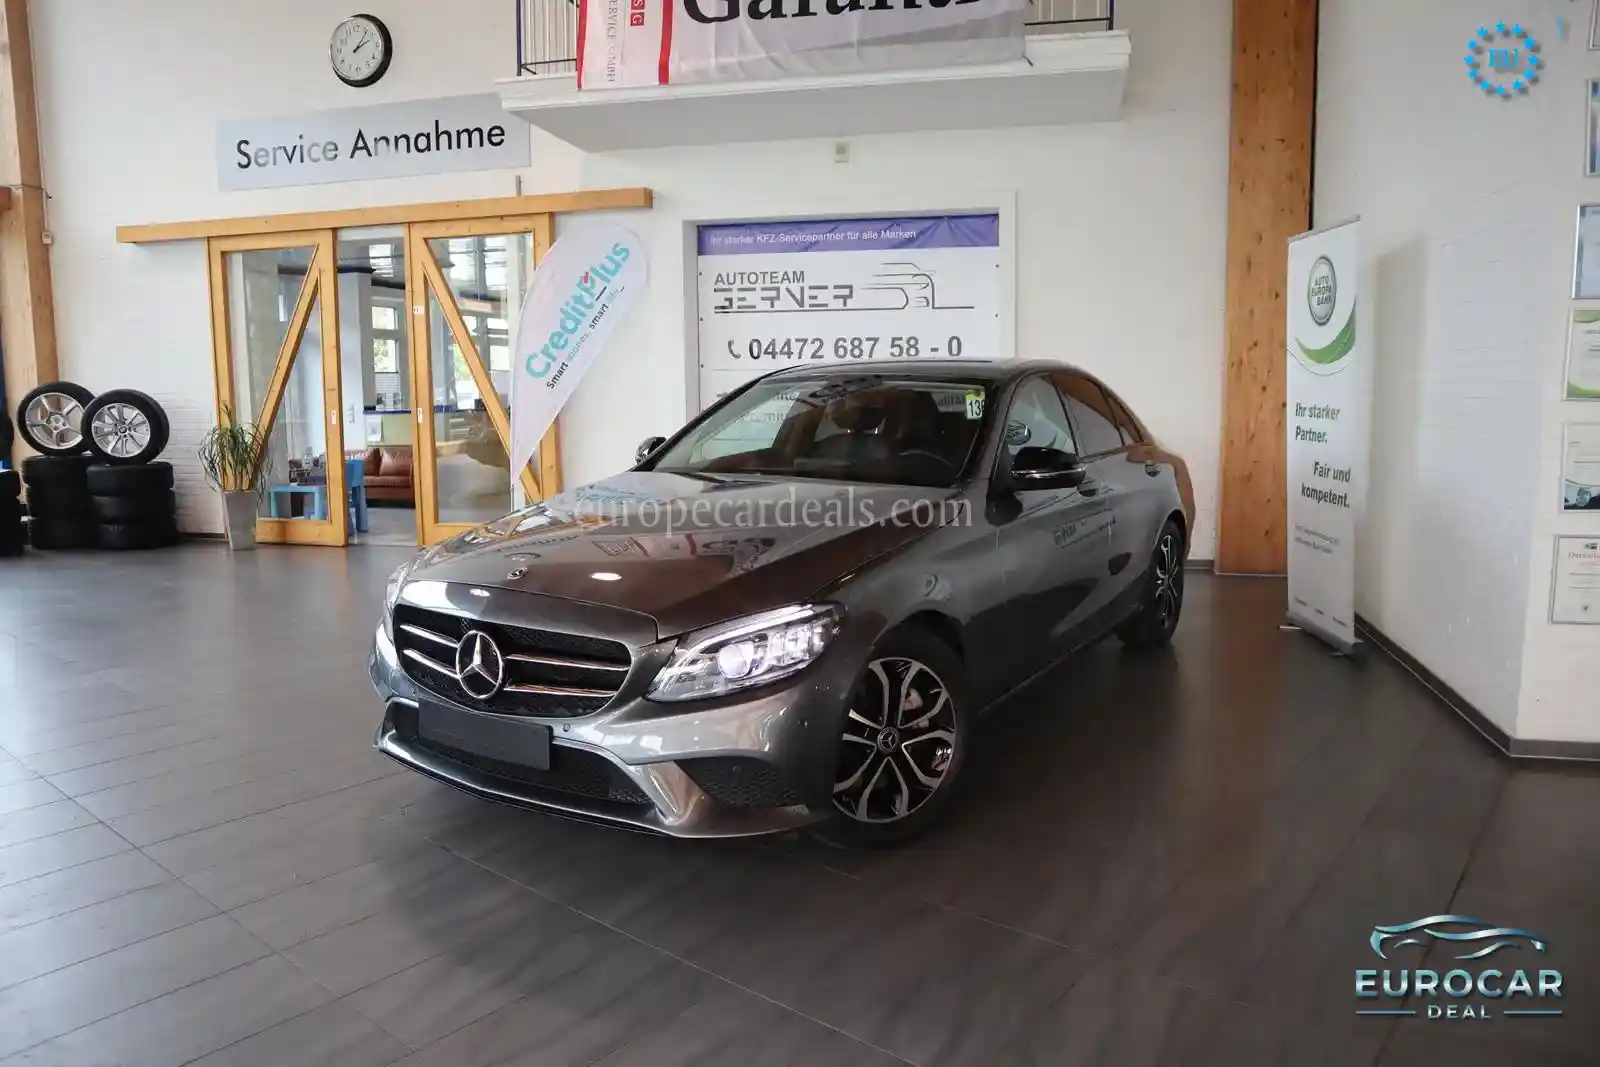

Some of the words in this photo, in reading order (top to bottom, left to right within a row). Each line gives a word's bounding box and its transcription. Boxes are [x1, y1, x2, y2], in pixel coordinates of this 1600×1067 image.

[236, 134, 339, 169] Service
[349, 119, 506, 159] Annahme
[756, 231, 844, 246] KFZ-Servicepartner
[847, 230, 860, 241] für
[862, 230, 878, 241] alle
[881, 229, 916, 241] Marken
[714, 270, 805, 286] AUTOTEAM
[748, 338, 825, 360] 04472
[834, 337, 880, 359] 687
[890, 336, 920, 358] 58
[947, 335, 962, 357] 0
[546, 361, 569, 389] Smart
[1295, 402, 1306, 417] Ihr
[1308, 405, 1341, 420] starker
[1295, 425, 1328, 444] Partner.
[1313, 460, 1331, 479] Fair
[1333, 467, 1351, 483] und
[1301, 482, 1350, 508] kompetent.
